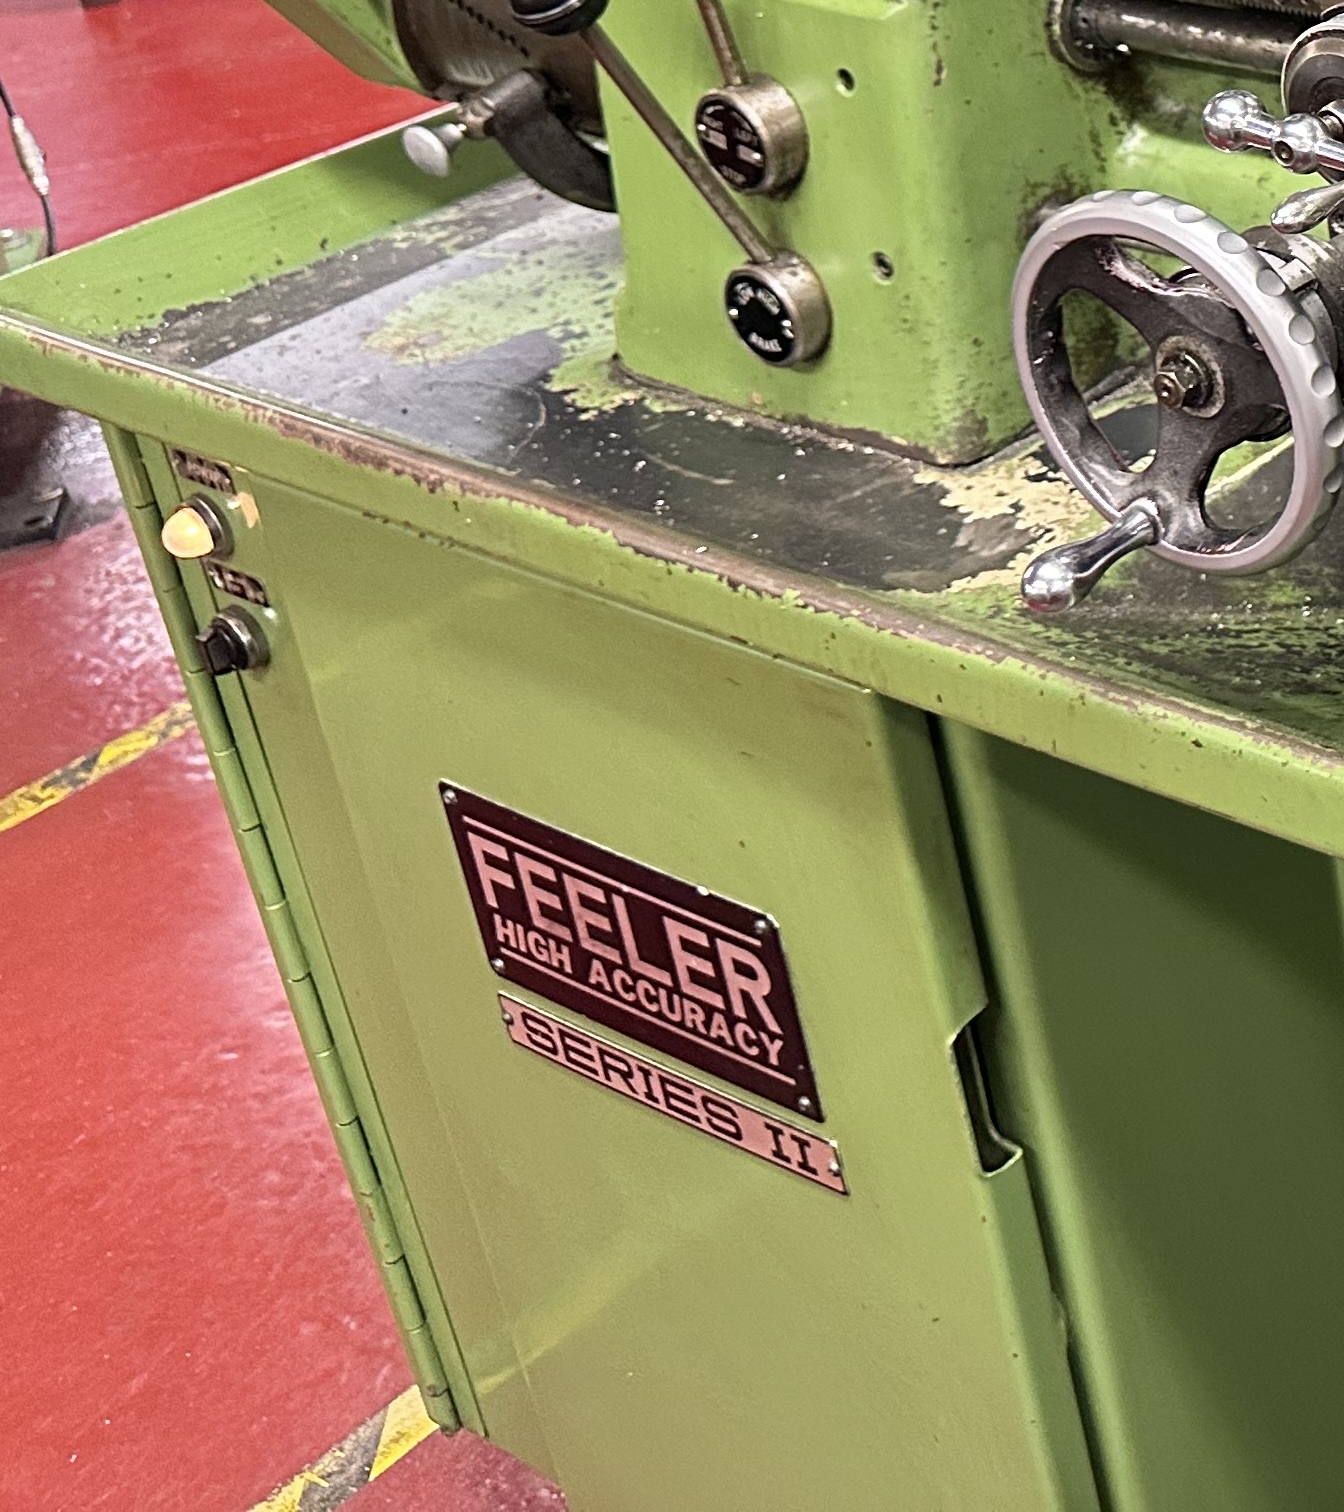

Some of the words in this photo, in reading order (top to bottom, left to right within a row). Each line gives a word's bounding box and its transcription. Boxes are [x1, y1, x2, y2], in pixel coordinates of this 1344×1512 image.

[466, 830, 784, 1036] FEELER
[493, 912, 573, 974] HIGH
[586, 960, 785, 1067] ACCURACY
[520, 1010, 744, 1143] SERIES
[763, 1122, 818, 1176] II
